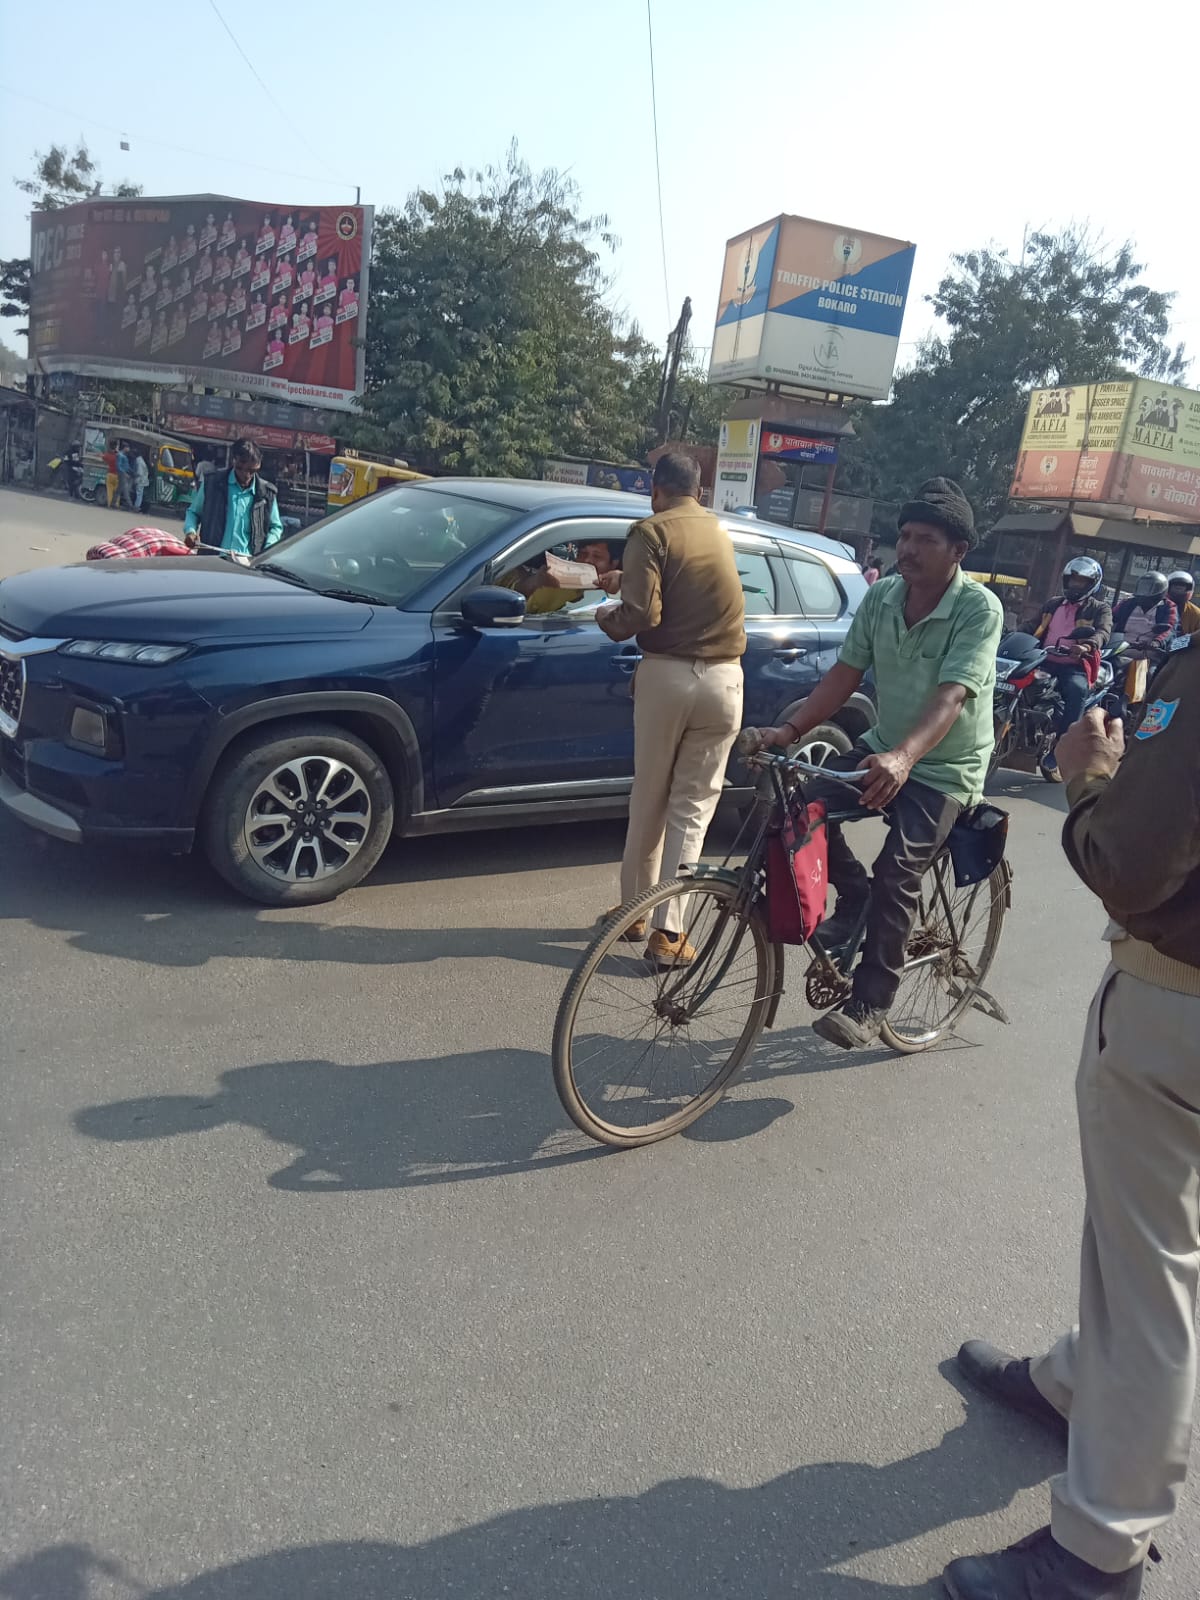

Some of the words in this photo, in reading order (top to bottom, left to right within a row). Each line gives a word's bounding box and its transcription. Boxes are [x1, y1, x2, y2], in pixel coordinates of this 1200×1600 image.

[33, 224, 65, 274] IPEC
[776, 269, 821, 290] TRAFFIC
[821, 279, 859, 298] POLICE
[859, 287, 904, 308] STATION
[817, 296, 858, 315] BOKARO
[1116, 384, 1129, 392] HALL
[1031, 418, 1067, 432] MAFIA
[1103, 425, 1120, 434] PARTY
[1131, 427, 1174, 450] MAFIA
